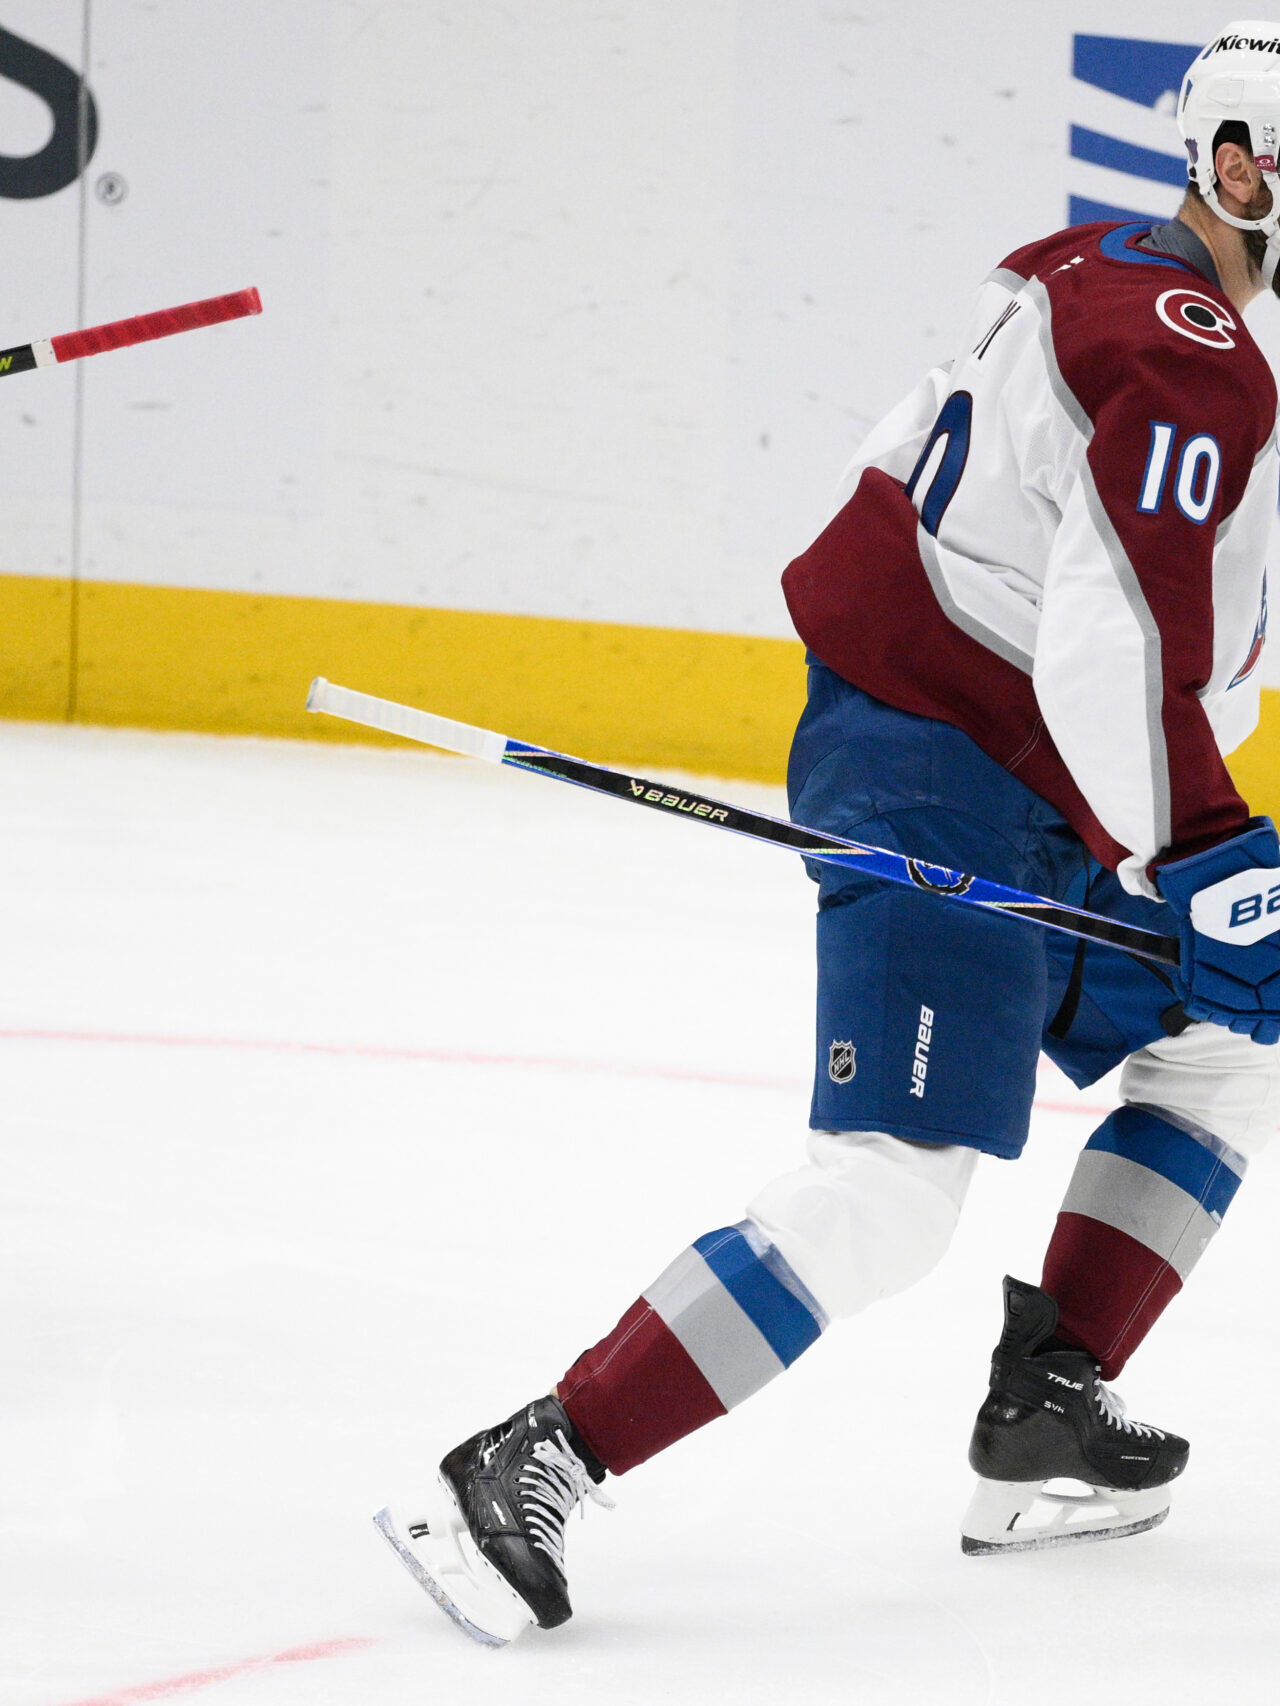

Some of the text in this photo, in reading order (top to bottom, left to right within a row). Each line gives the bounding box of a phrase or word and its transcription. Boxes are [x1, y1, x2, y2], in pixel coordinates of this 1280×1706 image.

[905, 390, 973, 538] 0
[1136, 419, 1222, 525] 10
[1047, 1372, 1084, 1391] TRUE
